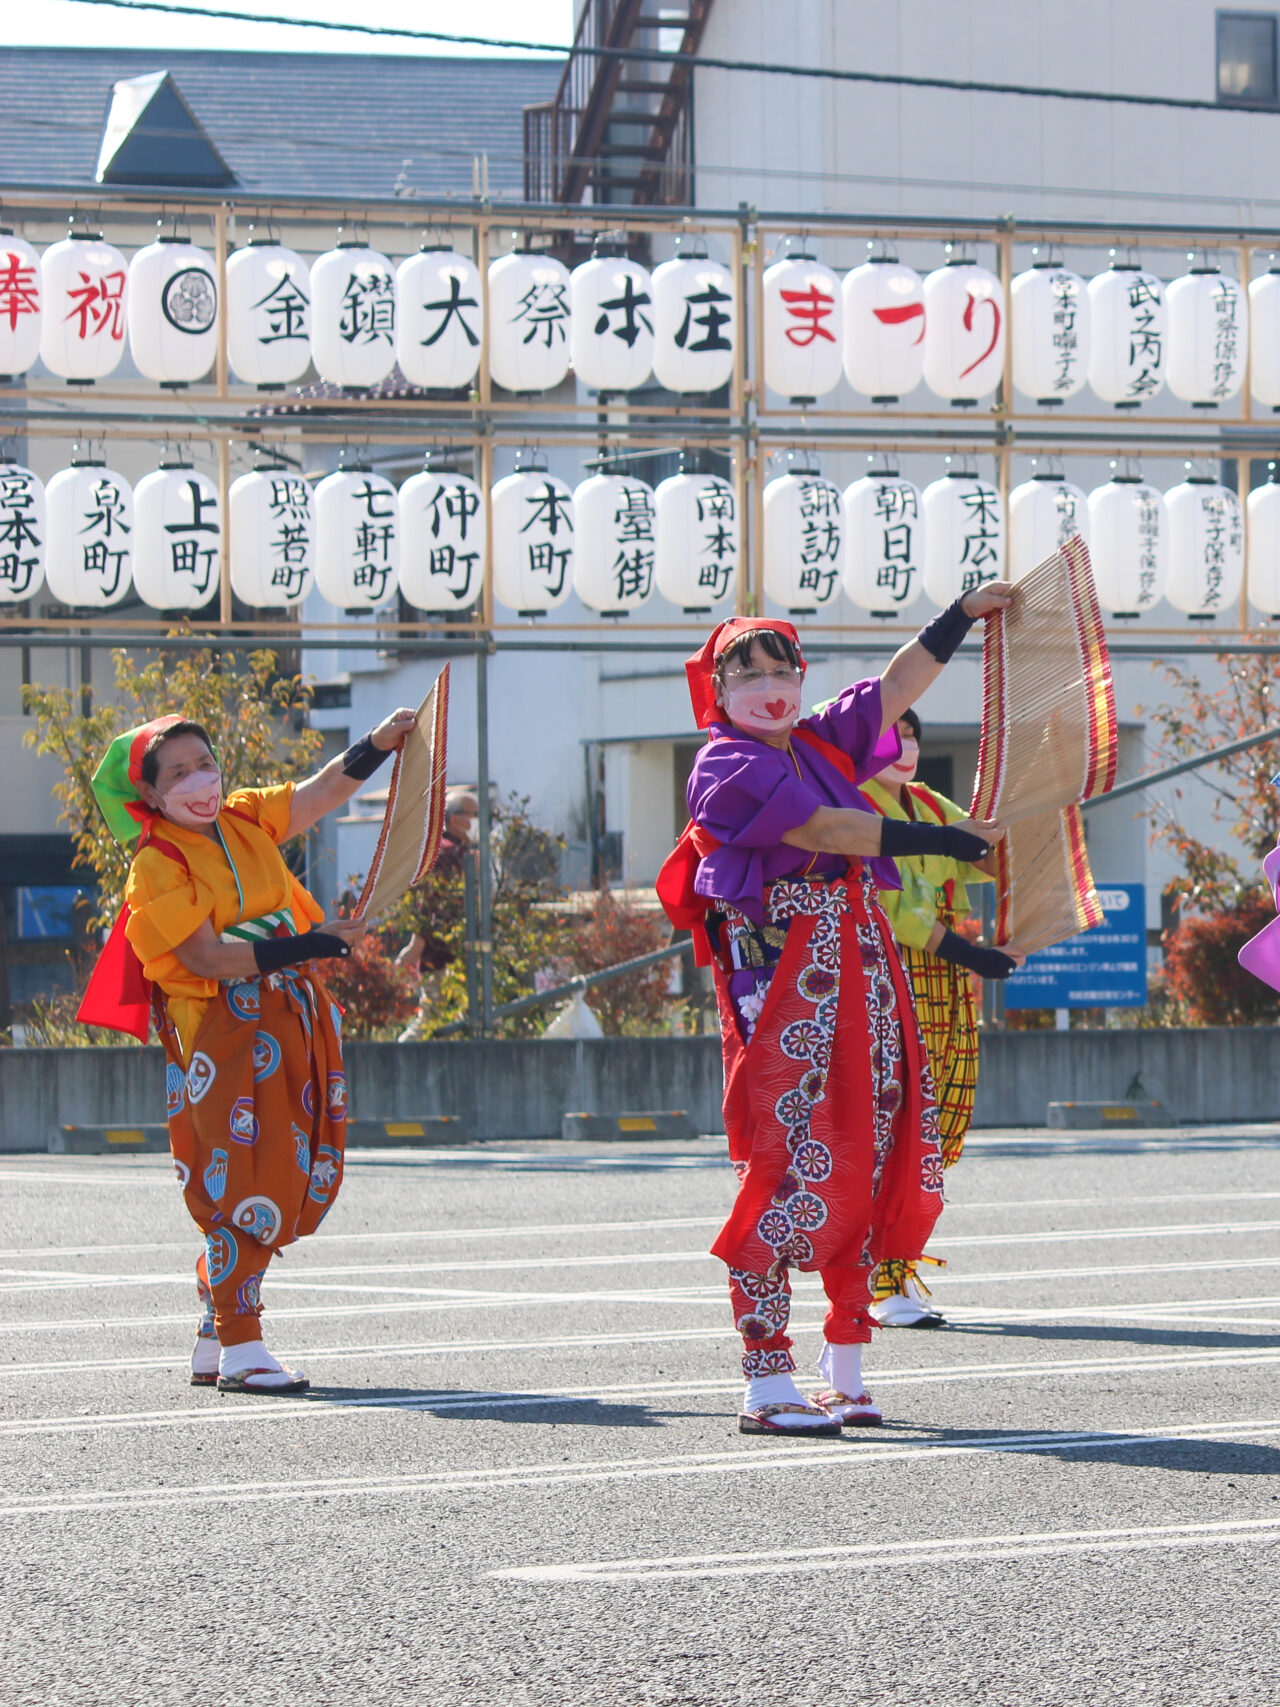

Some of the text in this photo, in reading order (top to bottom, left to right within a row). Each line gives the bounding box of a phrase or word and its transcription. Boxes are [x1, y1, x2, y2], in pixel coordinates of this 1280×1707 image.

[1126, 276, 1162, 397] 武之内会
[0, 470, 41, 594] 宮本町
[79, 479, 131, 597] 泉町
[164, 480, 220, 594] 上町
[268, 478, 312, 600] 照若町
[350, 480, 397, 601] 七軒町
[424, 484, 480, 599] 仲町
[519, 481, 574, 598] 本町
[696, 480, 736, 600] 南本町
[798, 481, 841, 602] 諏訪町
[874, 484, 917, 602] 朝日町
